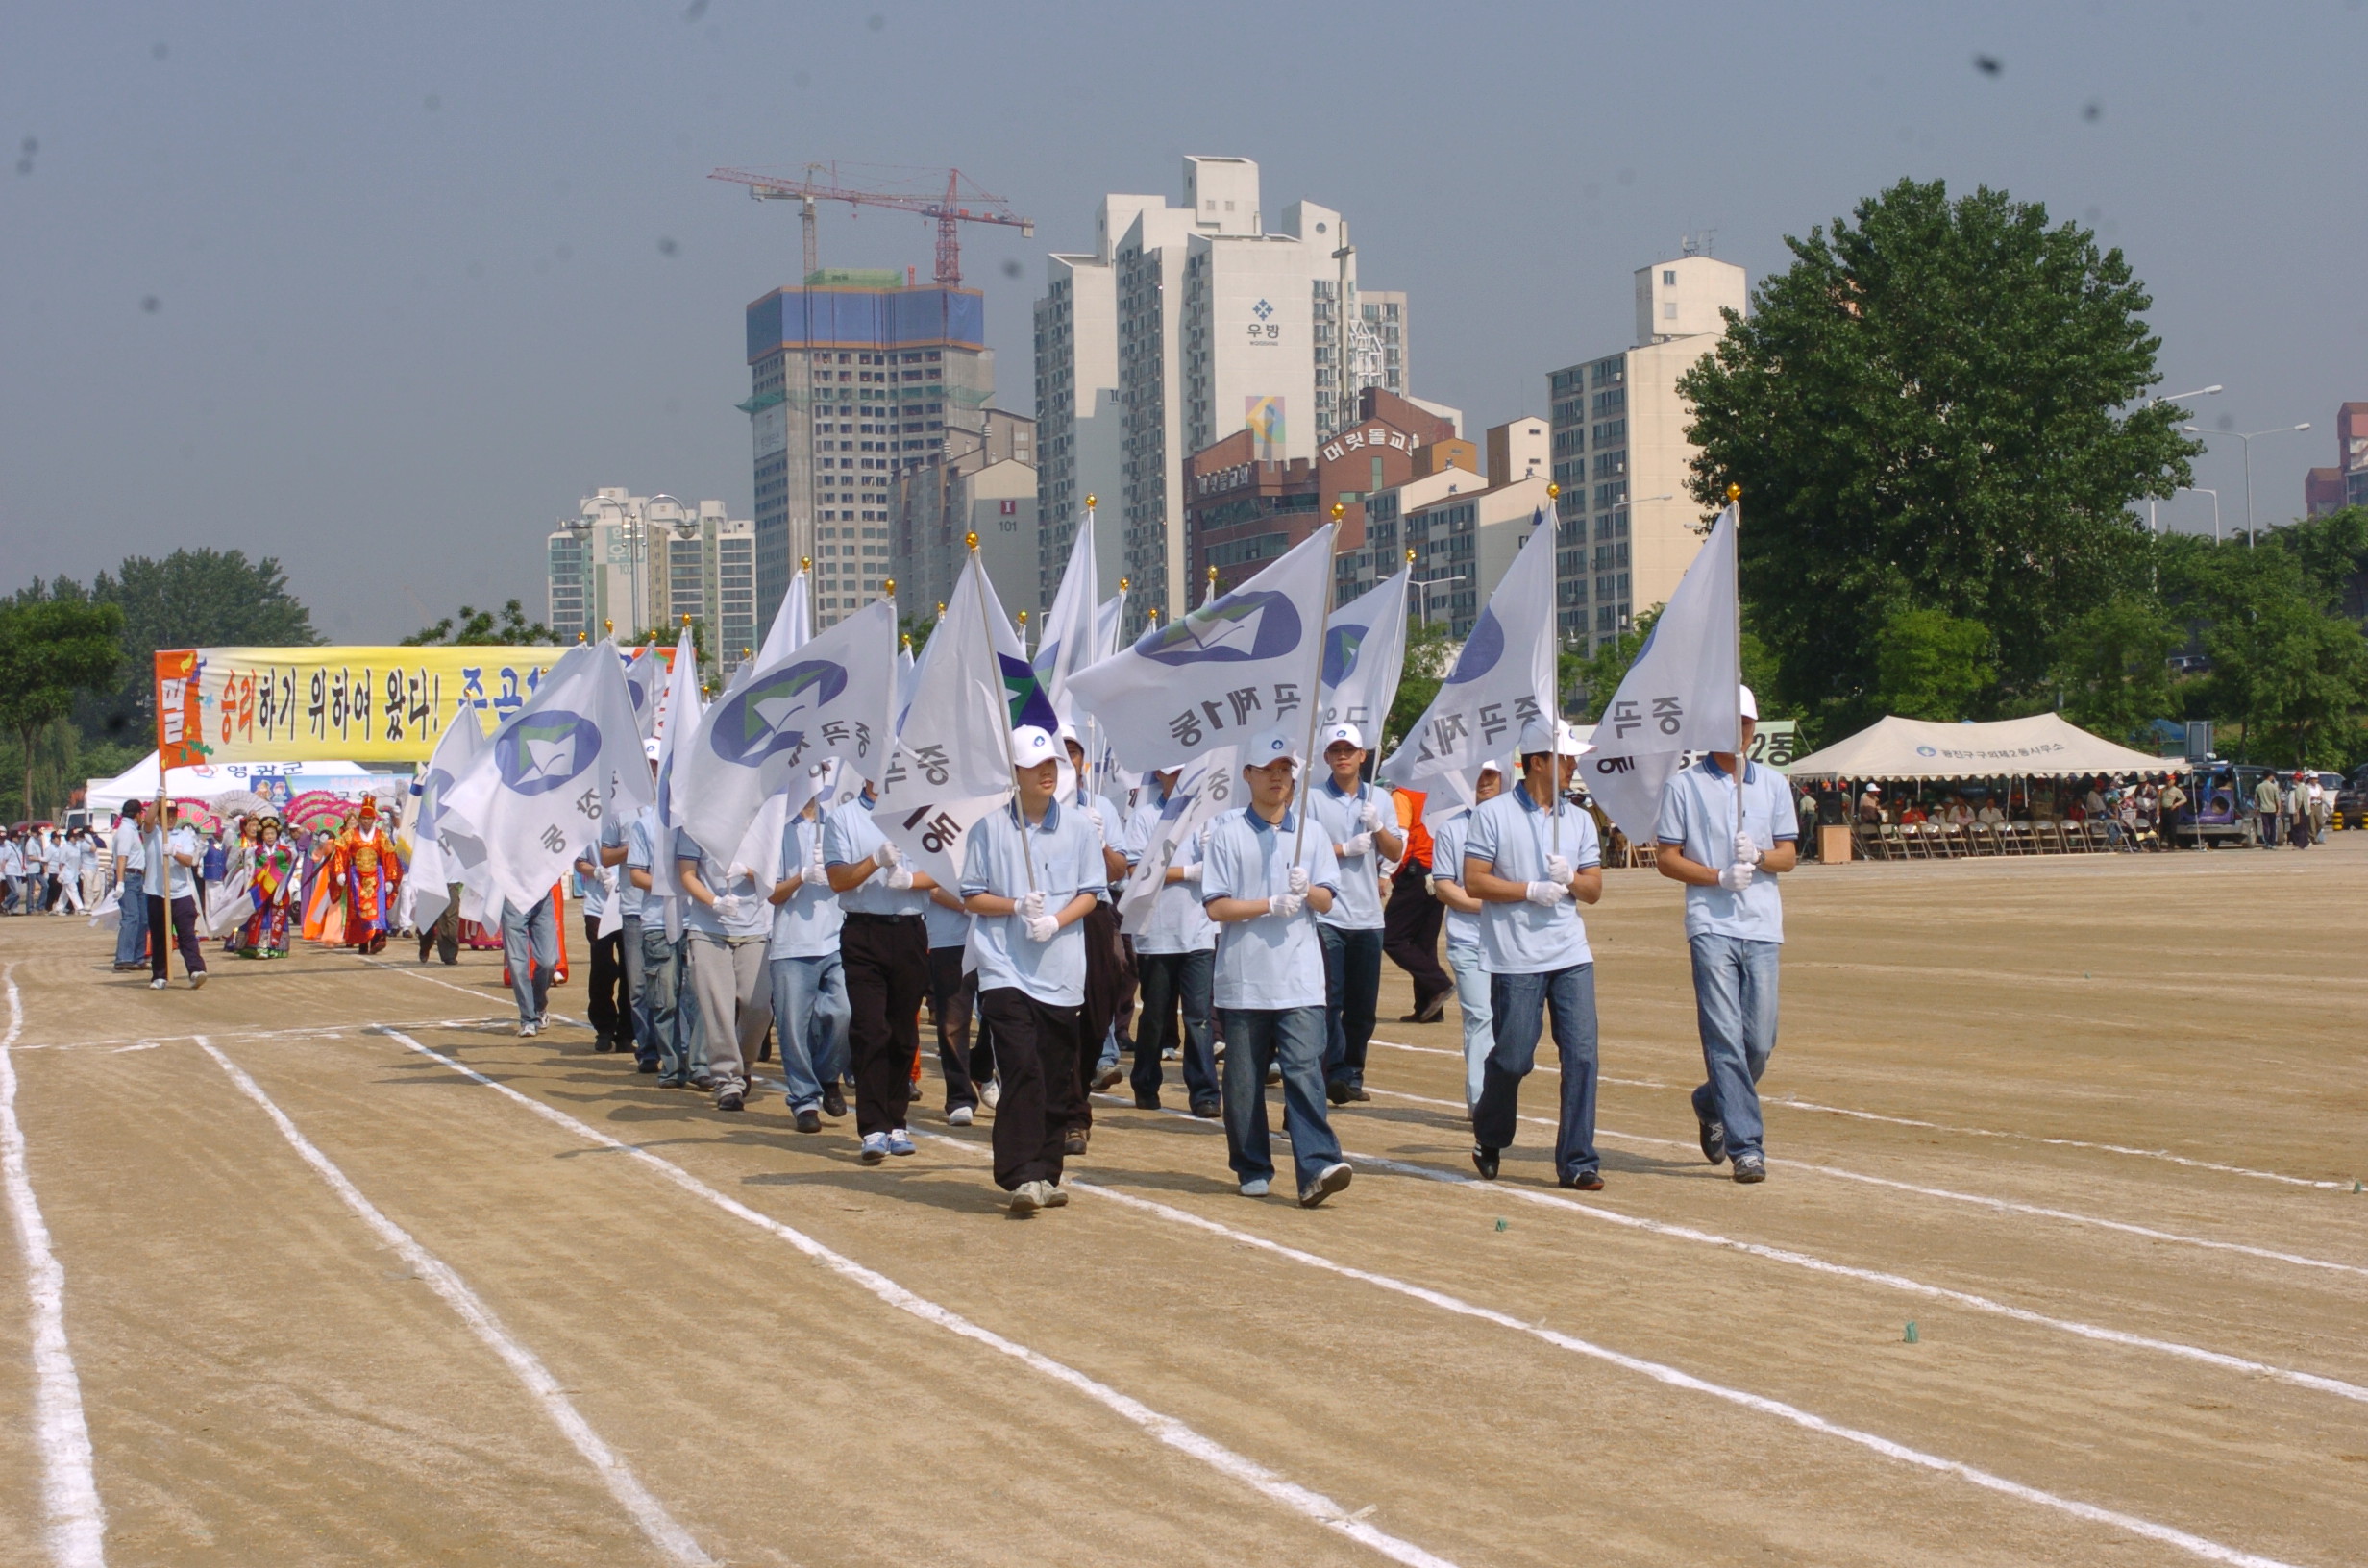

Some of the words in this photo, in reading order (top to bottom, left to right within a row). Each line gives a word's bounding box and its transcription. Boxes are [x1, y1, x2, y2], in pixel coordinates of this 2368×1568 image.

[1247, 324, 1279, 338] 우방
[999, 521, 1017, 532] 101
[220, 667, 296, 745] 승리하기
[308, 667, 371, 742] 위하여
[384, 667, 439, 742] 왔다!
[227, 761, 303, 778] 영광군
